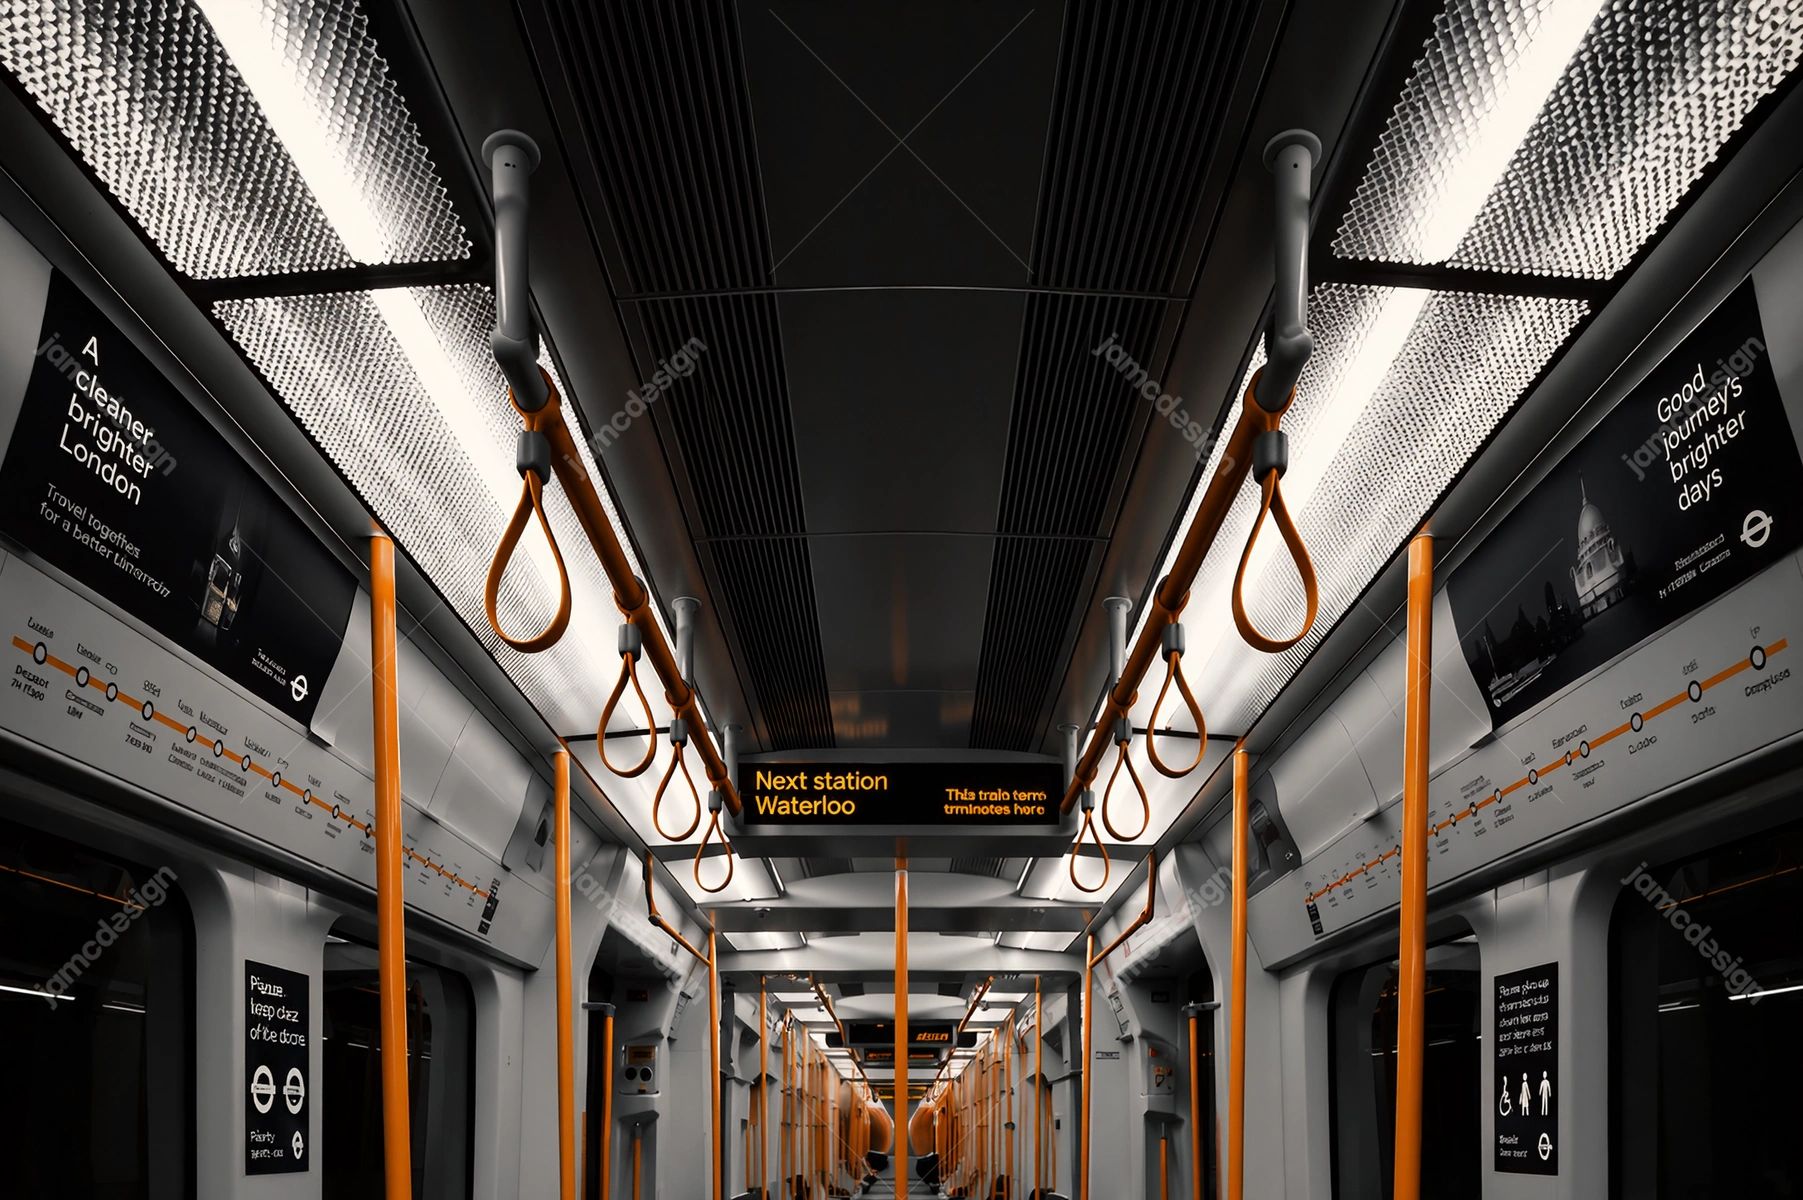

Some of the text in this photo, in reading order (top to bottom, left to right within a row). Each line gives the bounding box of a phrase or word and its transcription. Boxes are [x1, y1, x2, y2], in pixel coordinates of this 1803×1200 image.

[82, 336, 98, 366] A
[76, 370, 153, 445] cleaner
[1657, 363, 1706, 423] Good
[1662, 376, 1743, 461] journey's
[68, 392, 153, 478] brighter
[1669, 410, 1746, 483] brighter
[60, 423, 141, 505] London
[1678, 468, 1723, 511] days
[40, 502, 61, 524] for
[62, 519, 71, 532] a
[48, 483, 87, 520] Travel
[755, 795, 855, 815] Waterloo
[756, 770, 887, 790] Next station
